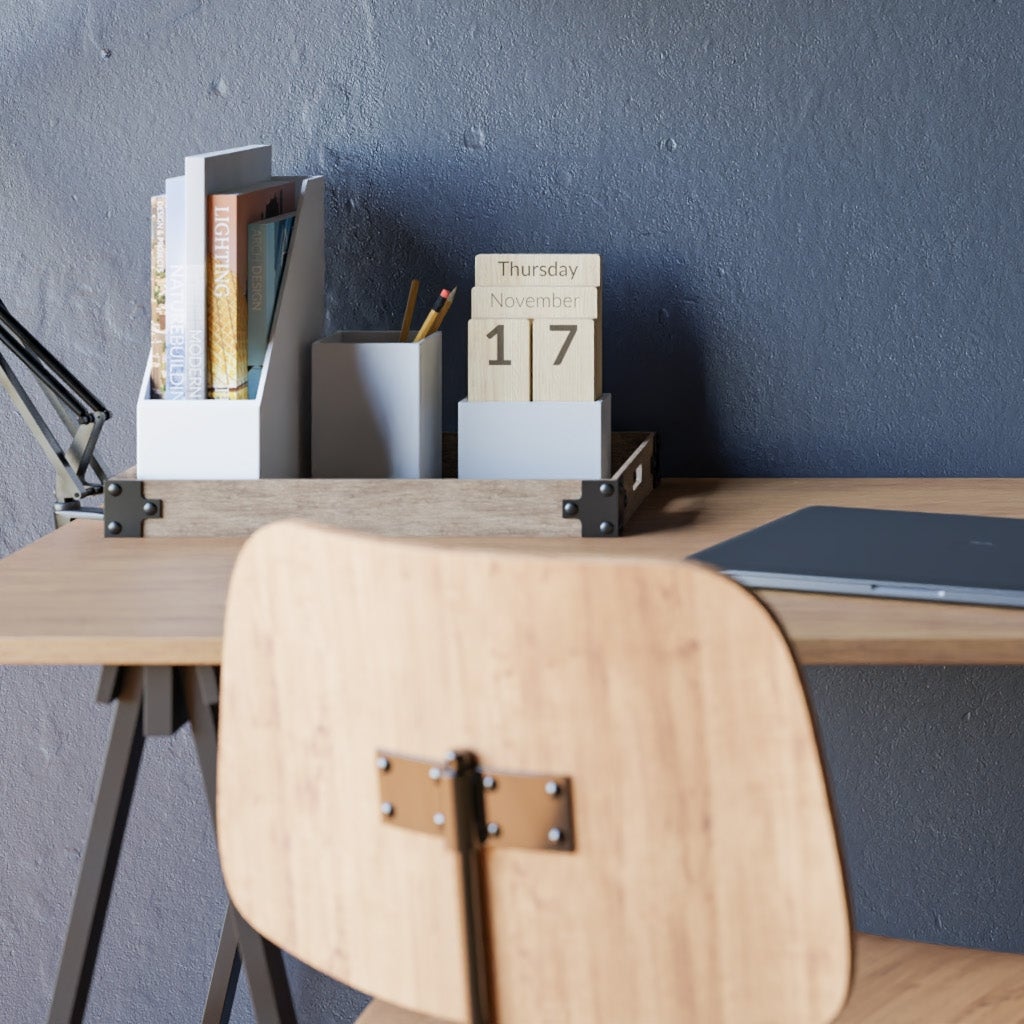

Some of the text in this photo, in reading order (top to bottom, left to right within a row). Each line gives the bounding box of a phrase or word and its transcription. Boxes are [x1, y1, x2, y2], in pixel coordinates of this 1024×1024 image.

[214, 205, 230, 298] LIGHTING
[497, 261, 579, 280] Thursday
[252, 264, 262, 311] DESIGN
[490, 292, 580, 308] November
[189, 329, 202, 399] MODERN
